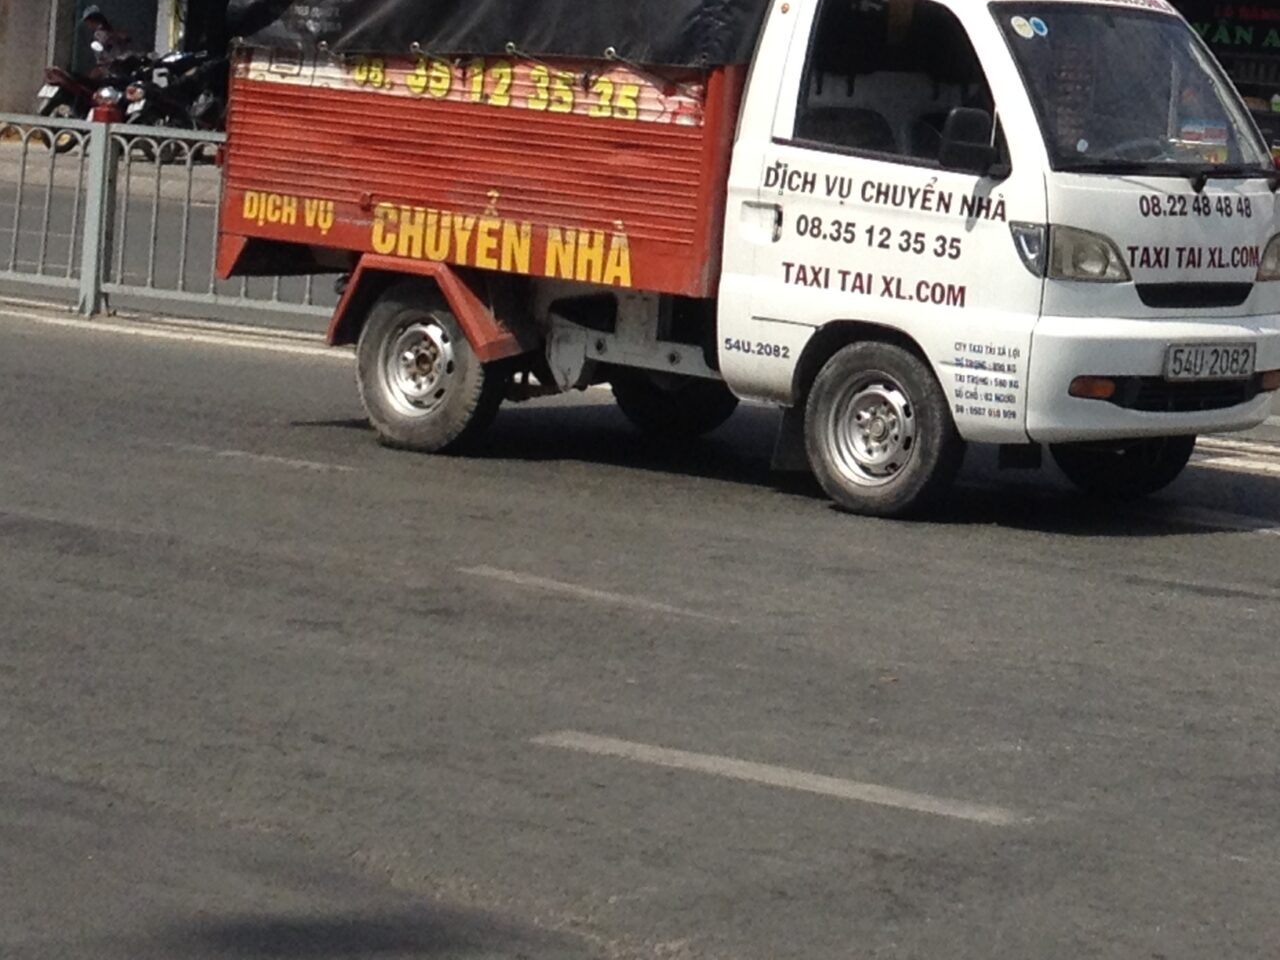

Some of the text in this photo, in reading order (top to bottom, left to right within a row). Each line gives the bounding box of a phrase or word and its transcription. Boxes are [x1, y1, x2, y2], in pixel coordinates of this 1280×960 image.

[407, 56, 452, 97] 35
[468, 57, 514, 107] 12
[527, 64, 575, 113] 35
[589, 76, 640, 121] 35
[763, 164, 1007, 222] DỊCH VỤ CHUYỂN NHÀ
[1139, 195, 1252, 218] 08.22 48 48 48
[242, 189, 633, 288] DỊCH VỤ CHUYỂN NHÀ
[796, 214, 962, 260] 08.35 12 35 35
[1127, 245, 1260, 269] TAXI TAI XL.COM
[781, 262, 967, 308] TAXI TAI XL.COM
[724, 338, 790, 358] 54U.2082
